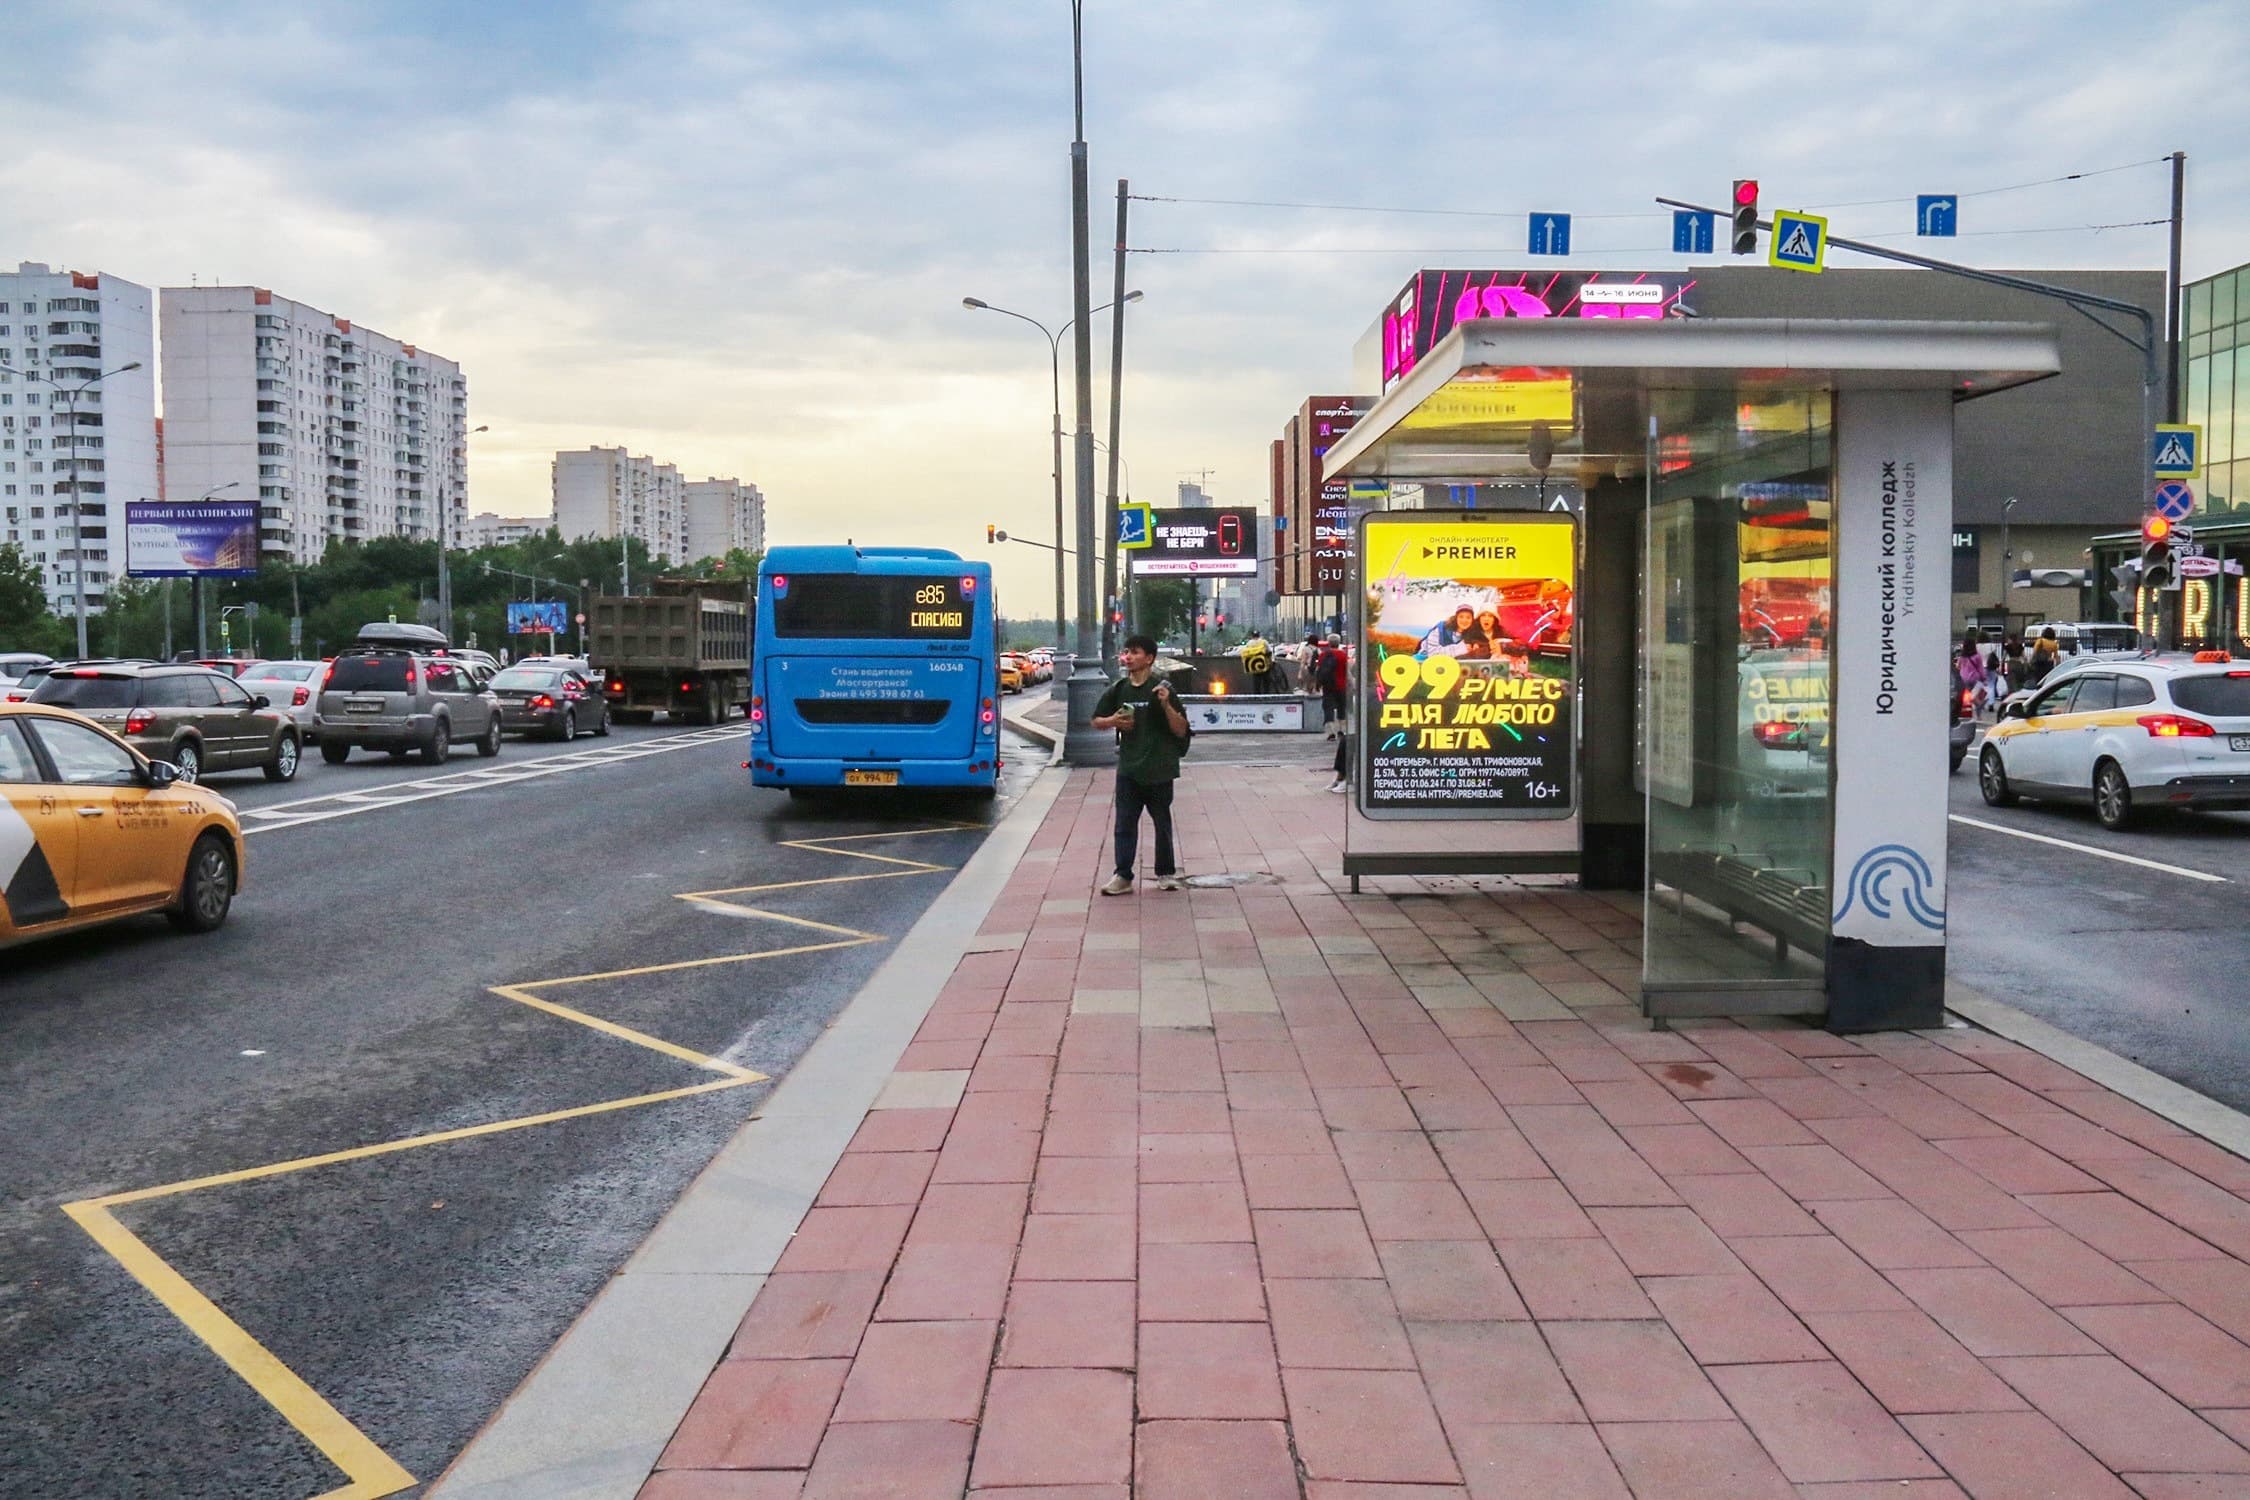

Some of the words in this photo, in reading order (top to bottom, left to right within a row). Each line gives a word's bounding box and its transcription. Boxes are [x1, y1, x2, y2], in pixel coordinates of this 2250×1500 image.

[1902, 462, 1916, 528] Kolledzh
[1881, 461, 1898, 557] колледж
[1156, 526, 1169, 537] НЕ
[1170, 526, 1208, 537] ЗНАЕШЬ
[1166, 538, 1179, 548] НЕ
[1180, 538, 1205, 548] БЕРИ
[1437, 547, 1516, 559] PREMIER
[1902, 531, 1916, 617] Yridiheskiy
[916, 585, 944, 604] e85
[911, 612, 962, 627] СПАСИБО
[1876, 563, 1898, 714] Юридический
[831, 667, 859, 676] Стань
[861, 668, 913, 677] водителем
[929, 663, 964, 672] 160348
[1380, 654, 1461, 699] 99
[819, 690, 848, 698] Звони
[850, 690, 856, 698] 8
[859, 690, 877, 698] 495
[880, 690, 898, 698] 398
[900, 690, 911, 698] 67
[914, 690, 924, 698] 61
[1380, 703, 1442, 728] ДЛЯ
[1451, 703, 1556, 724] ЛЮБОГО
[1417, 728, 1491, 749] ЛЕТА
[1374, 757, 1389, 766] ООО
[1419, 768, 1440, 777] ОФИС
[1459, 768, 1477, 777] ОГРН
[1374, 779, 1403, 789] ПЕРИОД
[1446, 779, 1456, 788] ПО
[1524, 781, 1561, 798] 16+
[1374, 790, 1416, 799] ПОДРОБНЕЕ
[1417, 790, 1427, 799] НА
